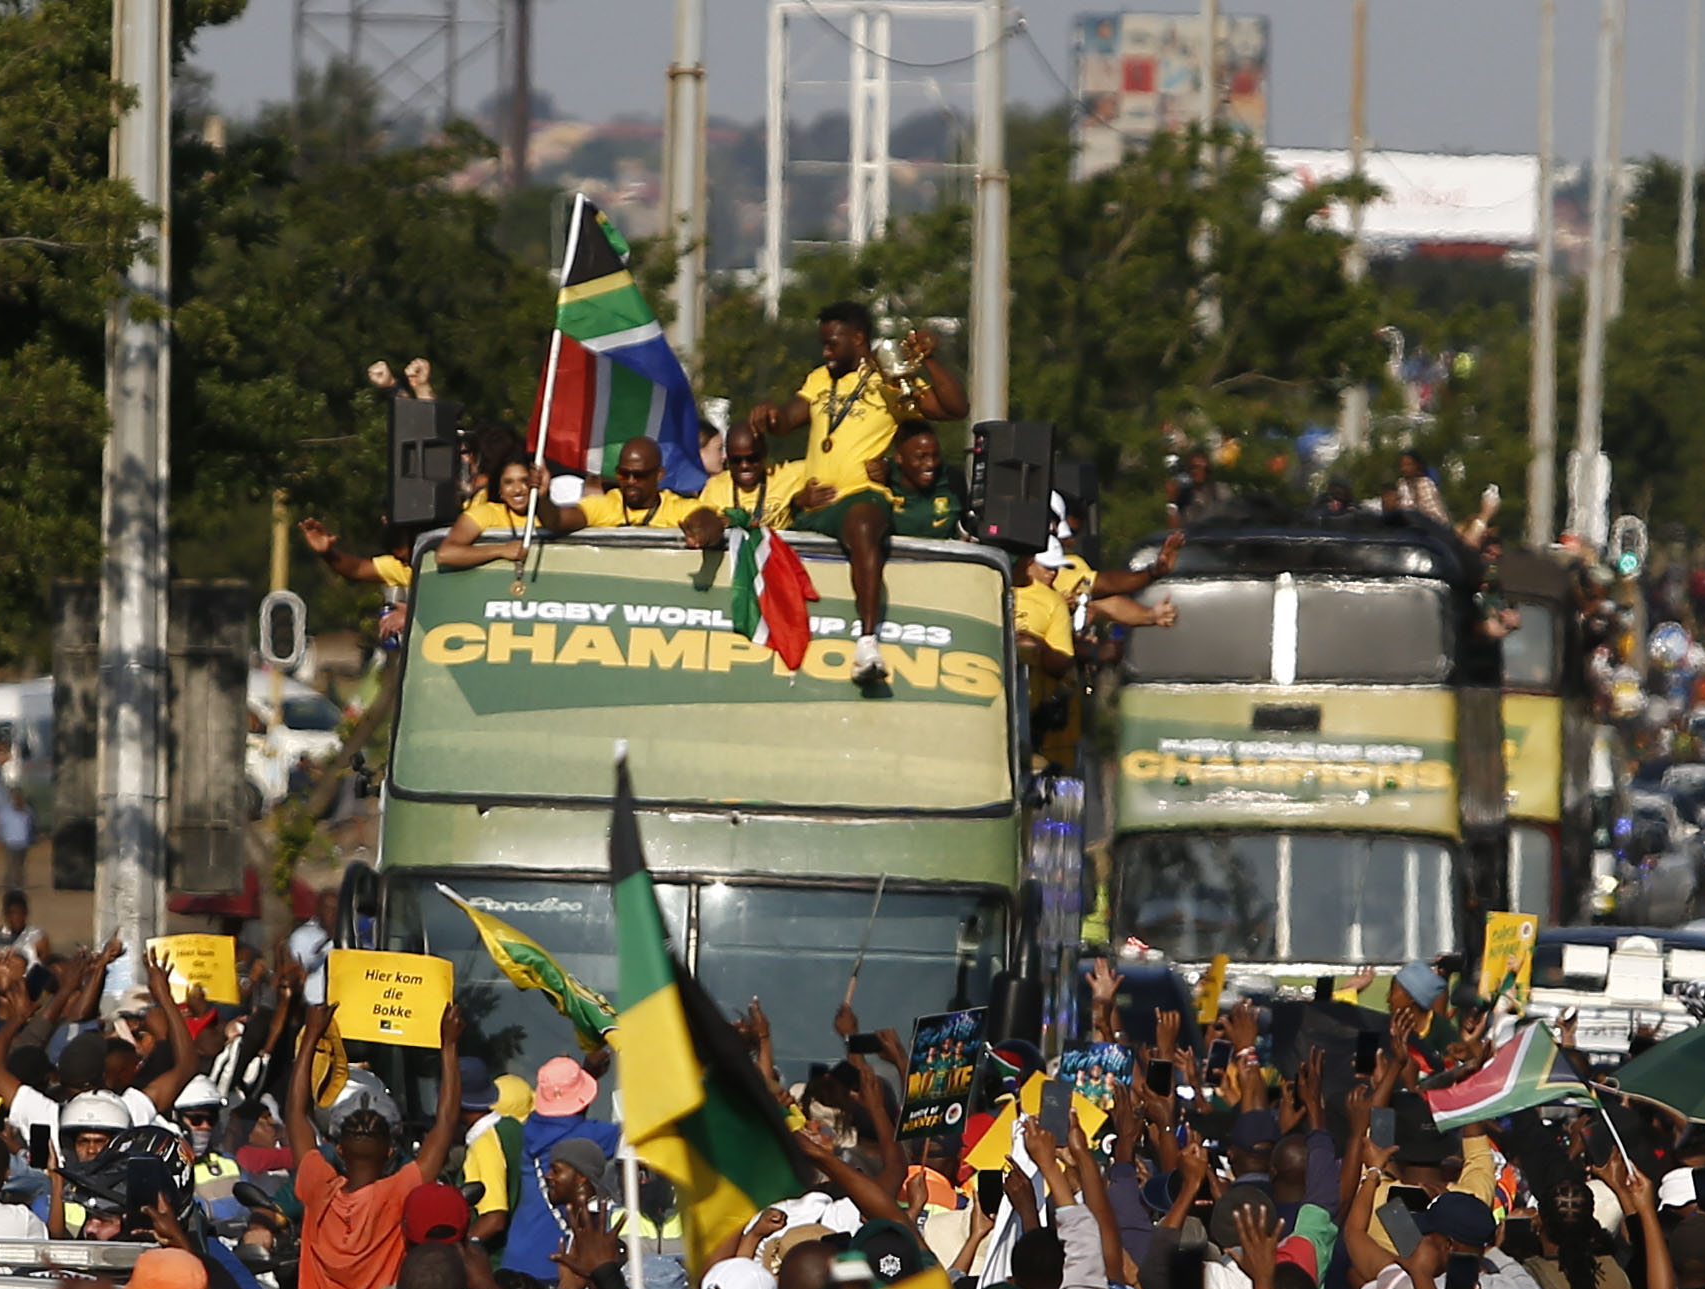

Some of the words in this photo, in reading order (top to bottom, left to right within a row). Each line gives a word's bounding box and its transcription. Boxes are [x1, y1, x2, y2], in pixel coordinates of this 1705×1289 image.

[484, 600, 617, 622] RUGBY
[623, 604, 734, 628] WORL
[421, 622, 1004, 698] CHAMPIONS
[365, 969, 392, 982] Hier
[395, 971, 423, 985] kom
[383, 988, 403, 1000] die
[373, 1004, 412, 1018] Bokke
